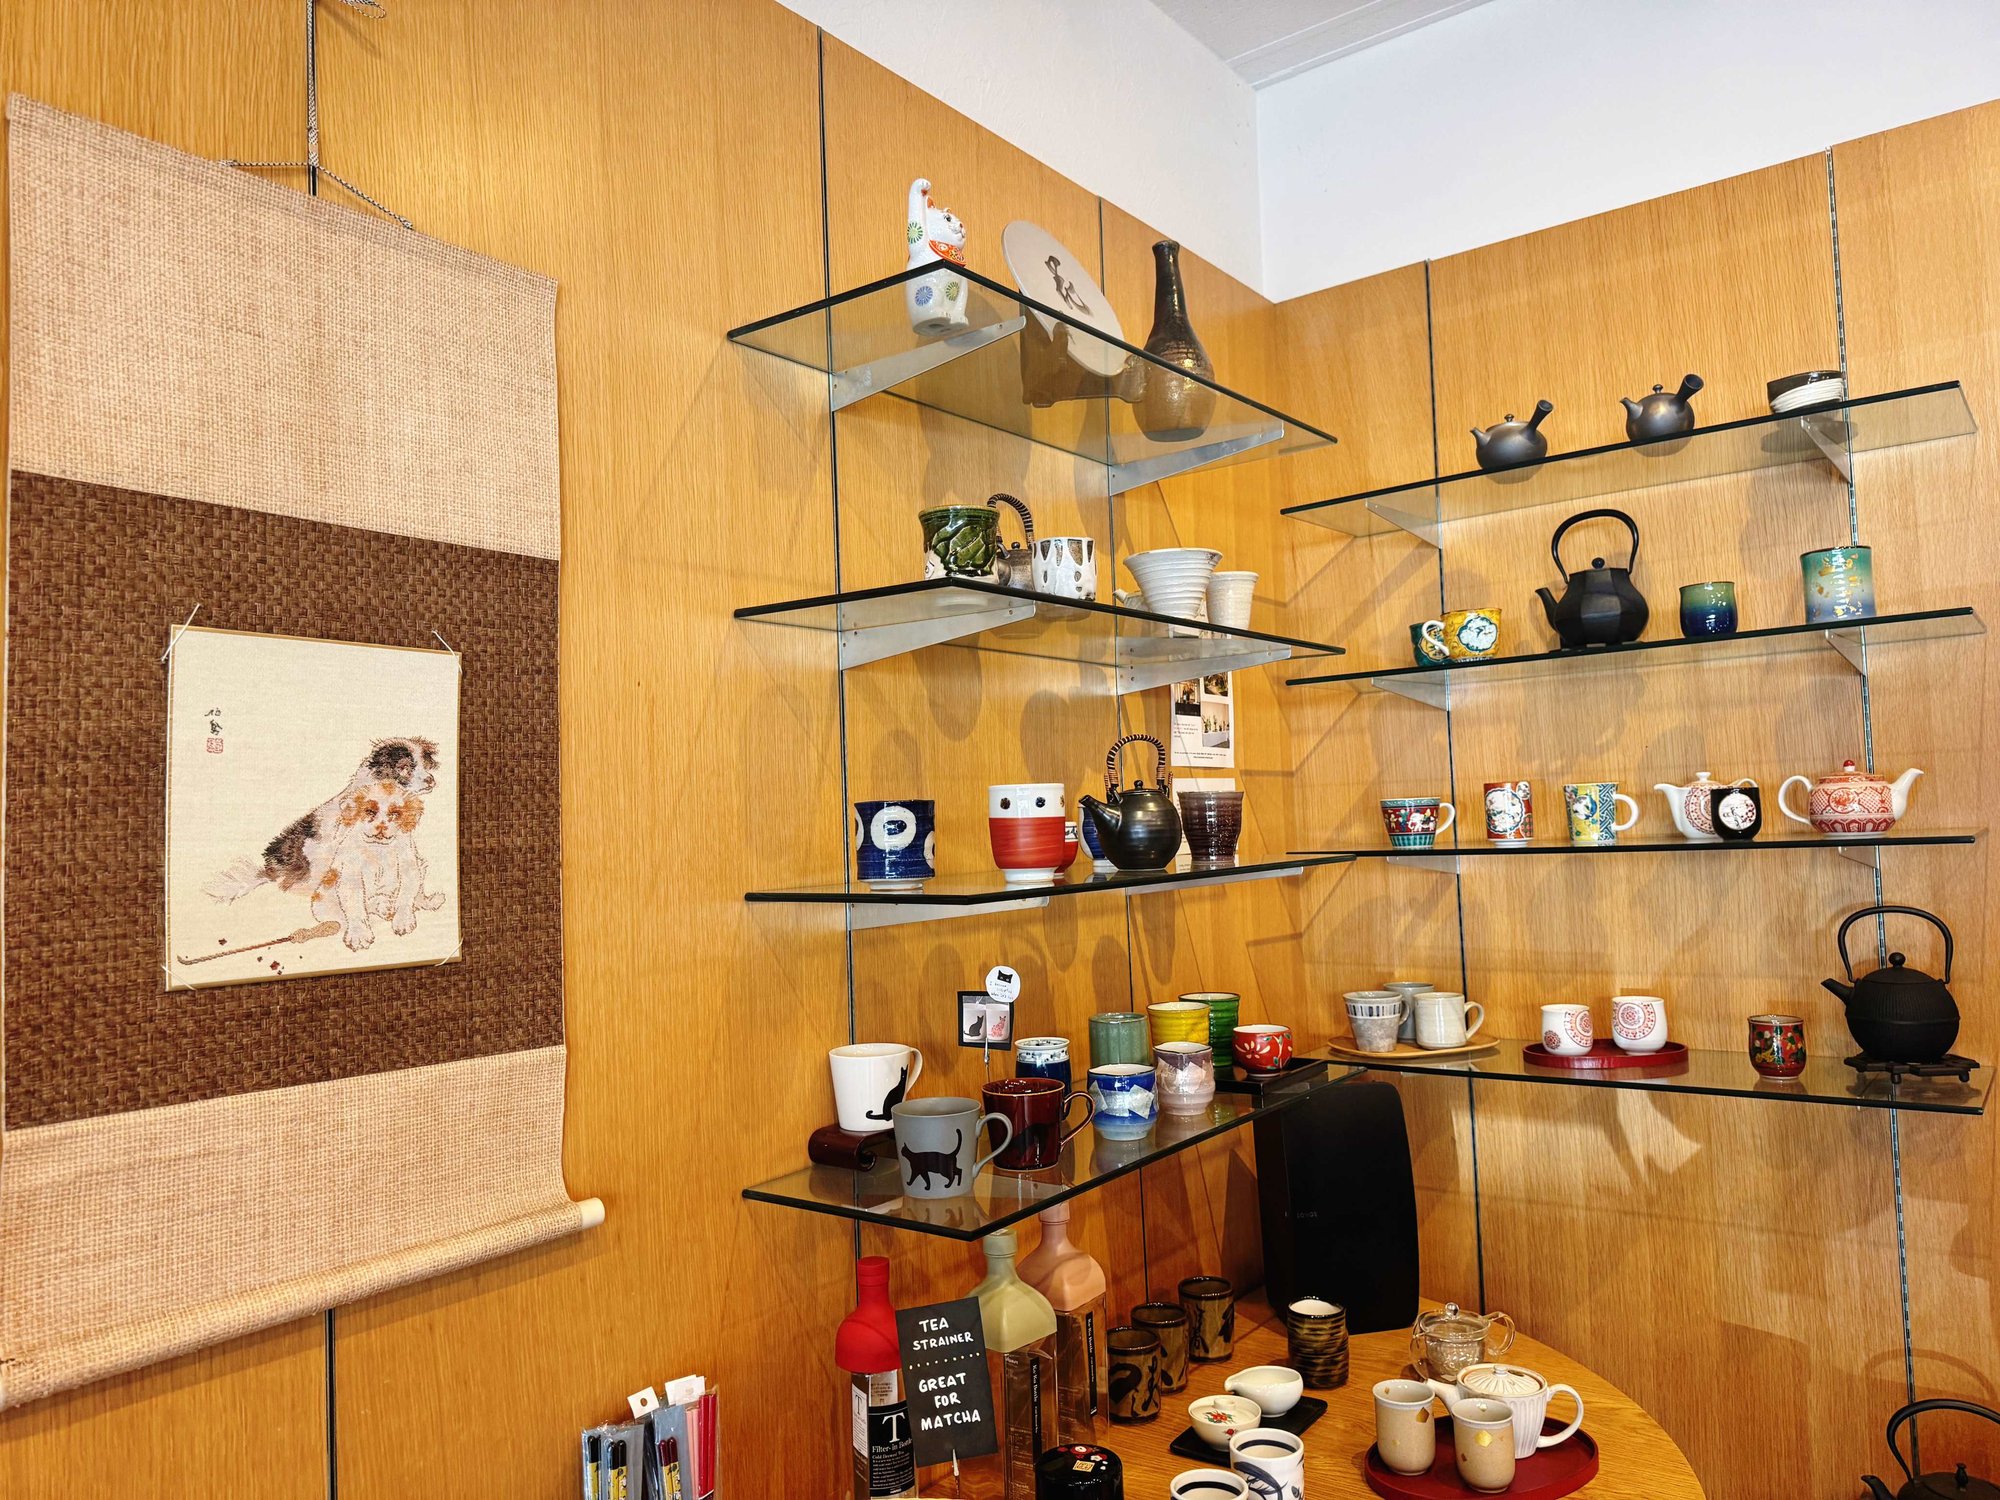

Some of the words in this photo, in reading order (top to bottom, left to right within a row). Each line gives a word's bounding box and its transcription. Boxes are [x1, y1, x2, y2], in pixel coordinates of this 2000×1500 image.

[919, 1317, 949, 1333] TEA
[912, 1331, 974, 1351] STRAINER
[919, 1372, 966, 1393] GREAT
[934, 1392, 962, 1409] FOR
[882, 1412, 906, 1443] T
[921, 1409, 981, 1431] MATCHA
